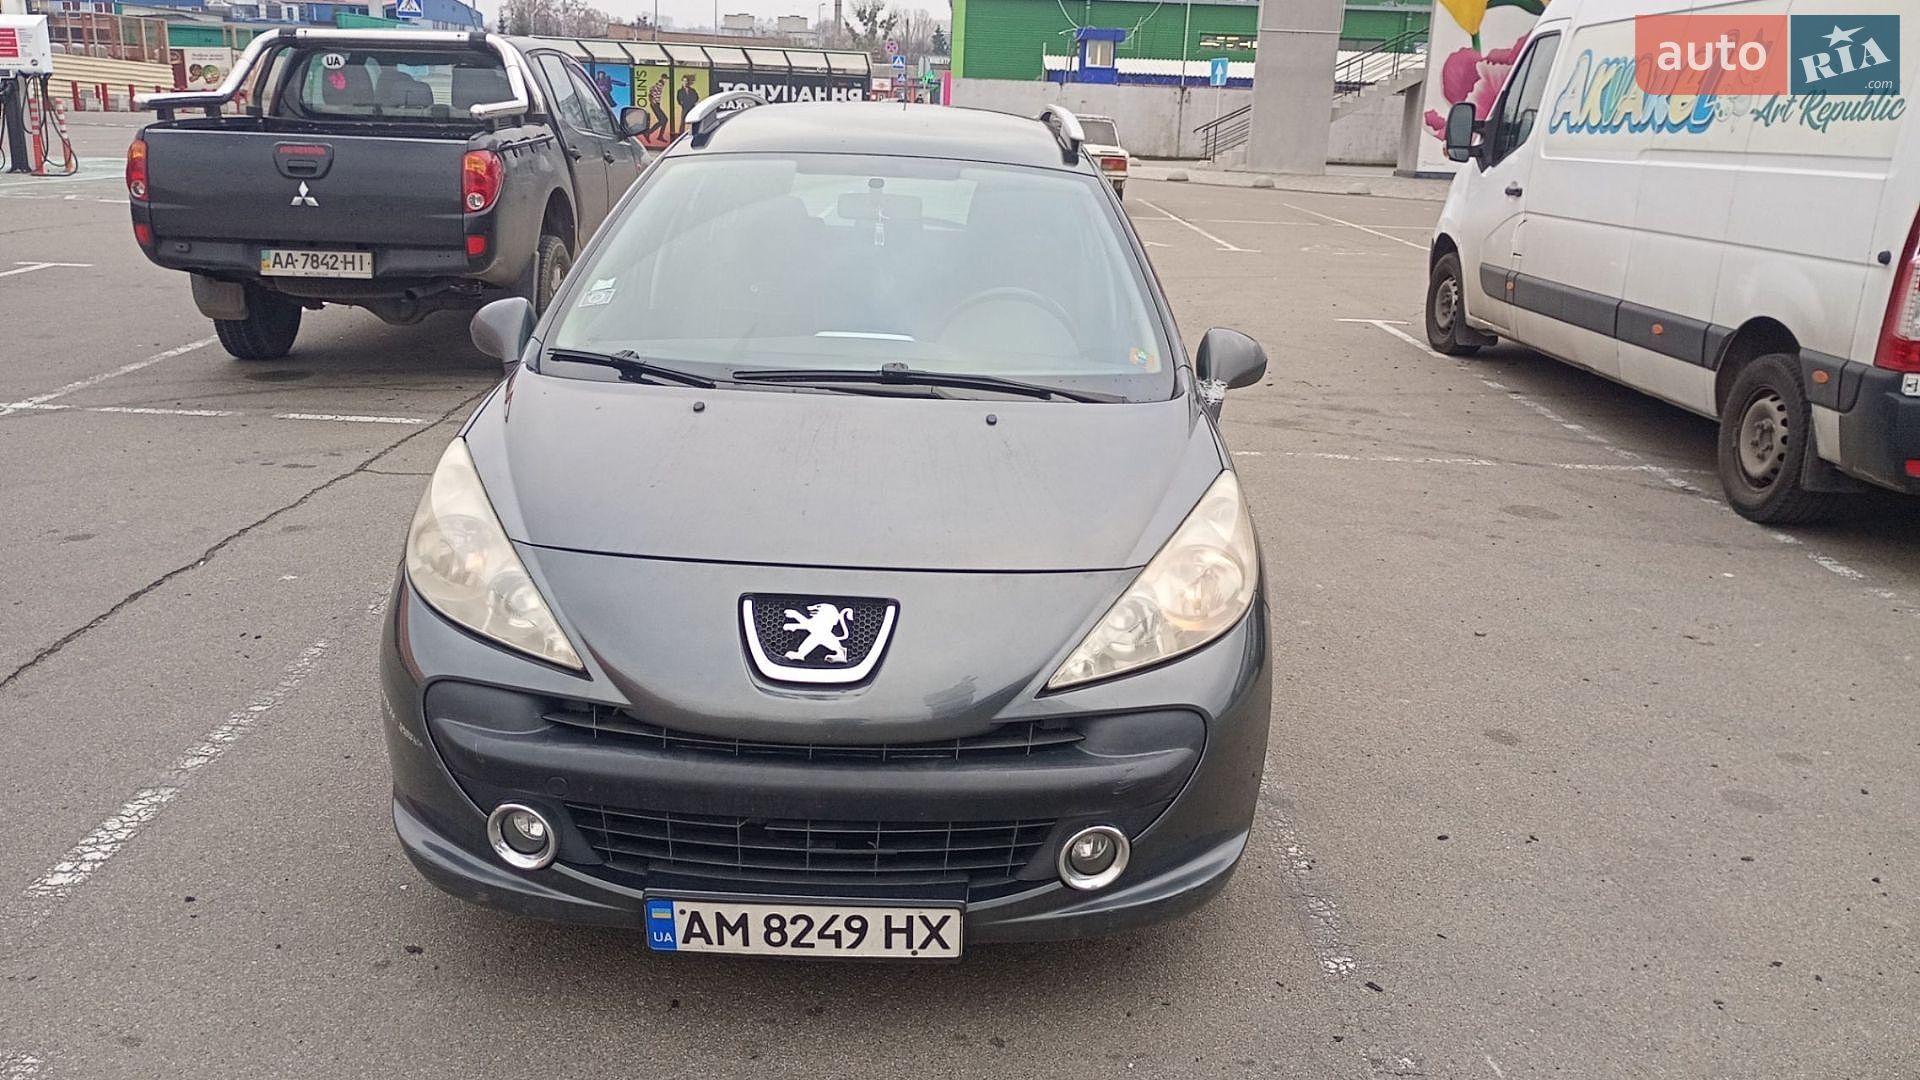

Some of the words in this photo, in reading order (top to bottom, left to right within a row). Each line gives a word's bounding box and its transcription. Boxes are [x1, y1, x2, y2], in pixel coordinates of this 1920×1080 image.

[326, 56, 341, 66] UA
[637, 70, 647, 107] OLIN'S
[1750, 90, 1797, 127] Art
[1800, 88, 1906, 133] Republic
[271, 252, 296, 269] AA
[300, 253, 339, 270] 7842
[653, 931, 673, 942] UA
[682, 910, 750, 947] AM
[763, 913, 869, 949] 8249
[884, 914, 952, 950] HX
